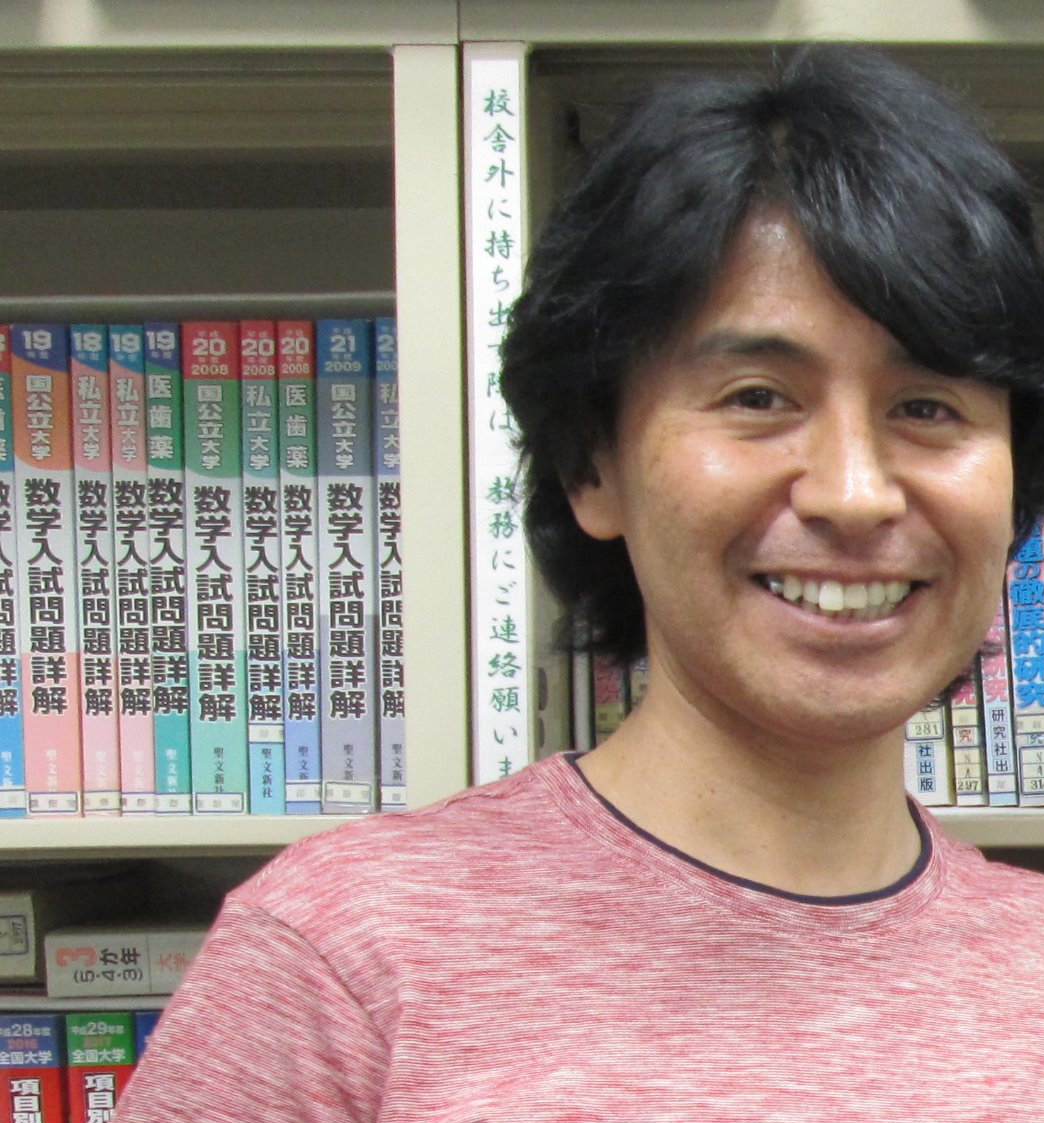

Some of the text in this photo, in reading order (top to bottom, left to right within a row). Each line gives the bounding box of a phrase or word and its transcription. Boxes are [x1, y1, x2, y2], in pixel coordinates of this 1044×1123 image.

[483, 88, 518, 431] 校舎外に持ち出は
[22, 330, 52, 350] 19
[72, 331, 102, 351] 18
[110, 333, 140, 352] 19
[145, 330, 175, 350] 19
[191, 364, 229, 376] 2008
[192, 338, 226, 356] 20
[242, 338, 275, 356] 20
[242, 365, 276, 376] 2008
[281, 337, 310, 355] 20
[281, 363, 310, 375] 2008
[324, 361, 362, 373] 2009
[330, 335, 356, 353] 21
[26, 374, 54, 461] 国公立大学
[77, 375, 102, 461] 私立大学
[115, 377, 140, 462] 私立大学
[149, 374, 174, 460] 医歯薬
[197, 384, 224, 470] 国公立大学
[246, 385, 273, 471] 私立大学
[285, 384, 309, 469] 医歯薬
[331, 384, 357, 469] 国公立大学
[24, 477, 67, 715] 数学入試問題詳解
[77, 479, 114, 717] 数学入試問題詳解
[114, 480, 151, 716] 数学入試問題詳解
[148, 477, 189, 715] 数学入試問題詳解
[193, 485, 237, 722] 数学入試問題詳解
[244, 485, 282, 722] 数学入試問題詳解
[283, 484, 318, 721] 数学入試問題詳解
[327, 482, 367, 719] 数学入試問題詳解
[915, 724, 939, 736] 281
[957, 780, 978, 792] 297
[72, 1049, 126, 1063] 全国大学
